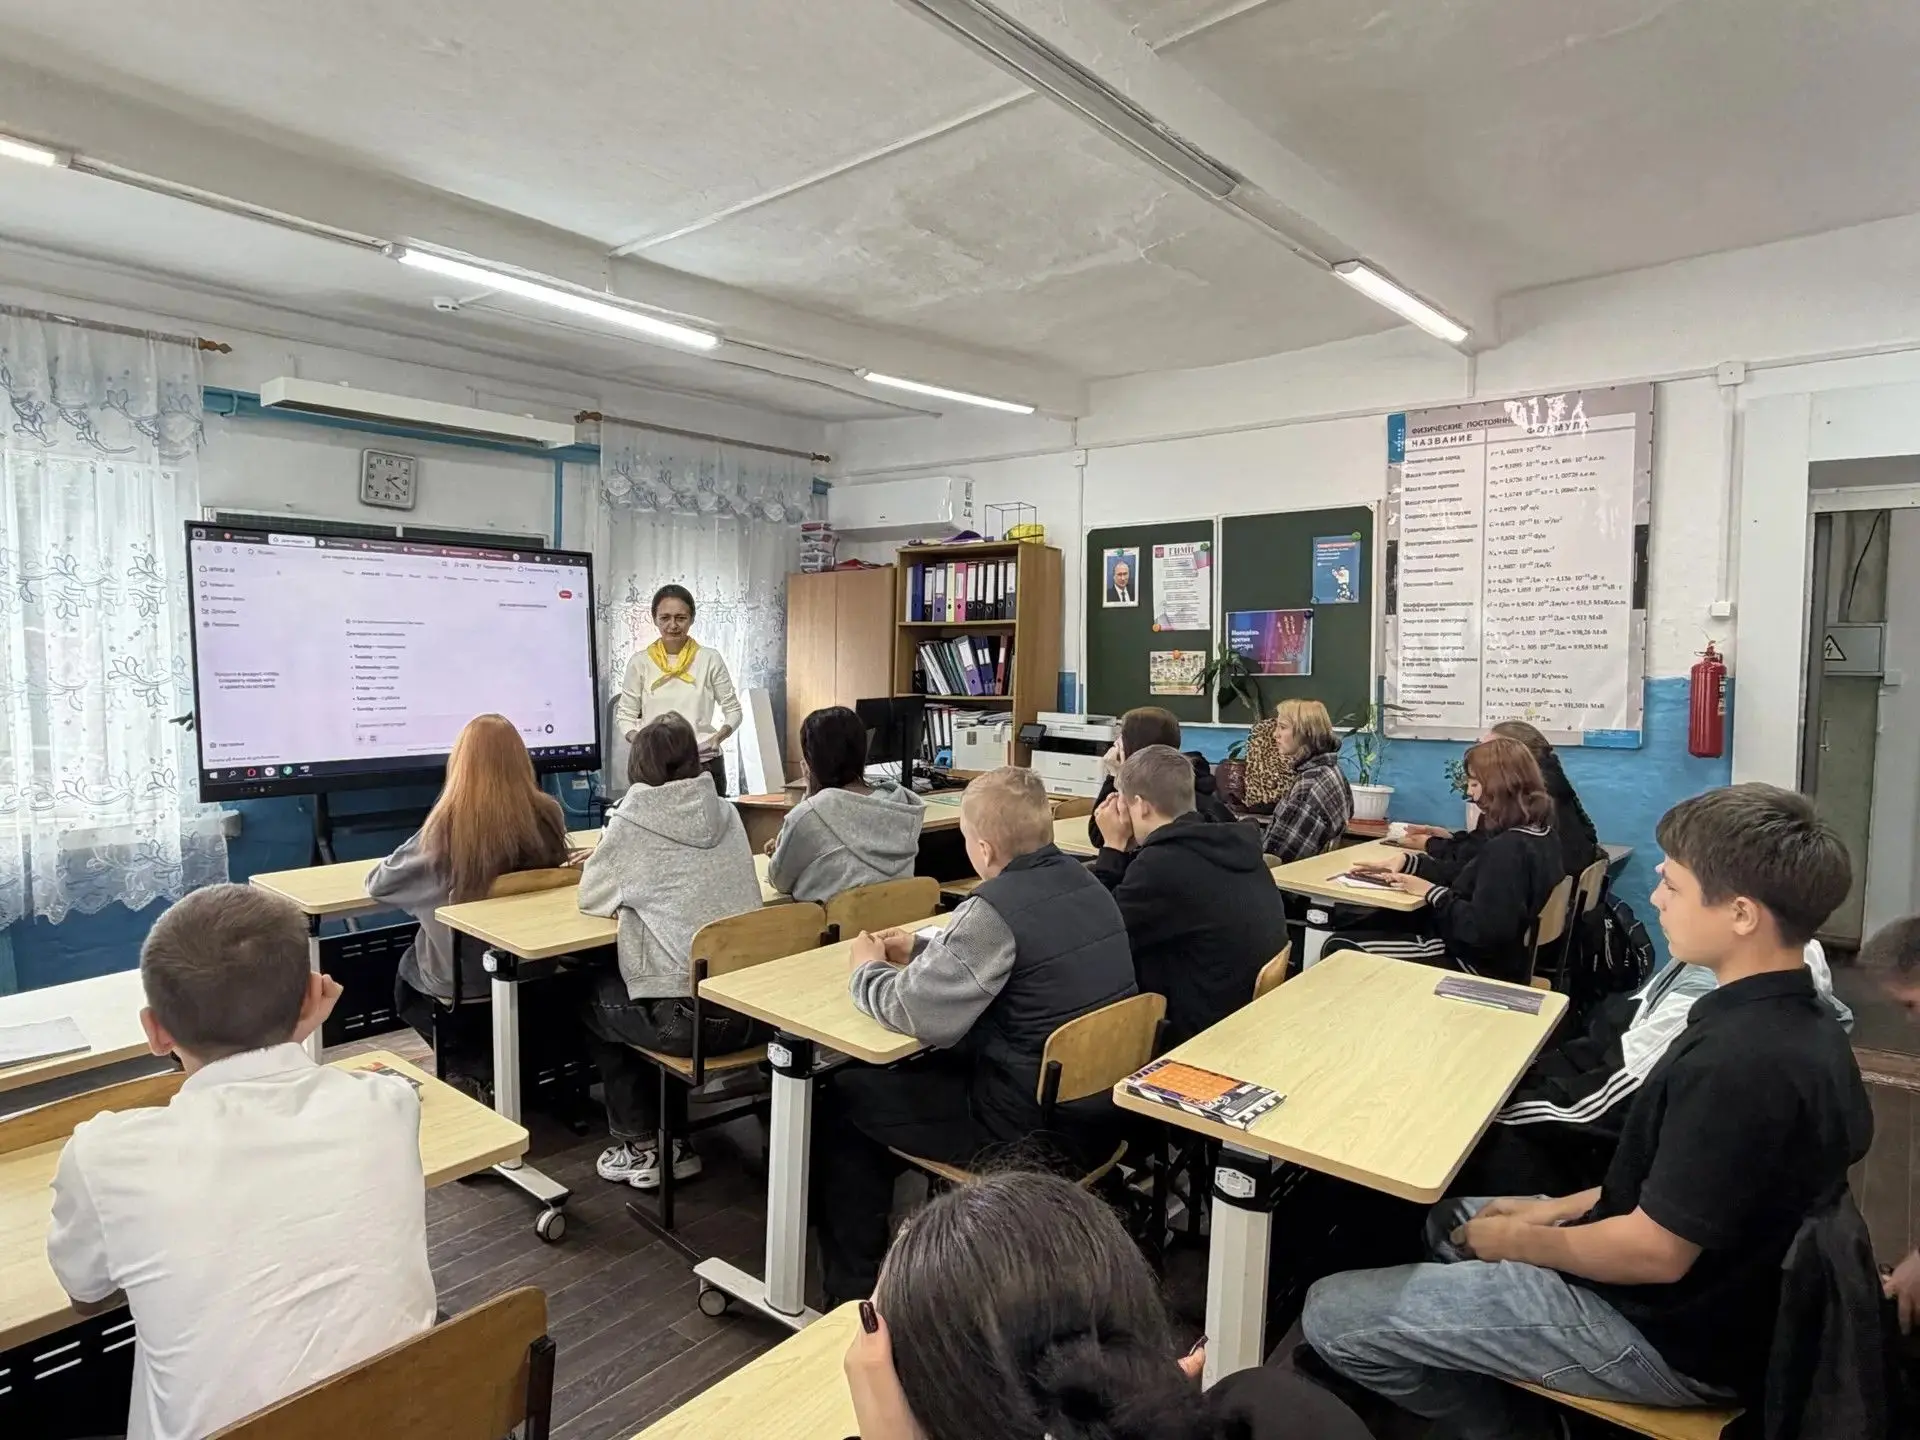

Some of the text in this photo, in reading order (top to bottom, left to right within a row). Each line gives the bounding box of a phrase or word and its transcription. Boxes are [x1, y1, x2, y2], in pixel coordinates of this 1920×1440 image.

[1411, 416, 1514, 434] ФИЗИЧЕСКИЕ ПОСТОЯНН
[1412, 434, 1472, 448] НАЗВАНИЕ
